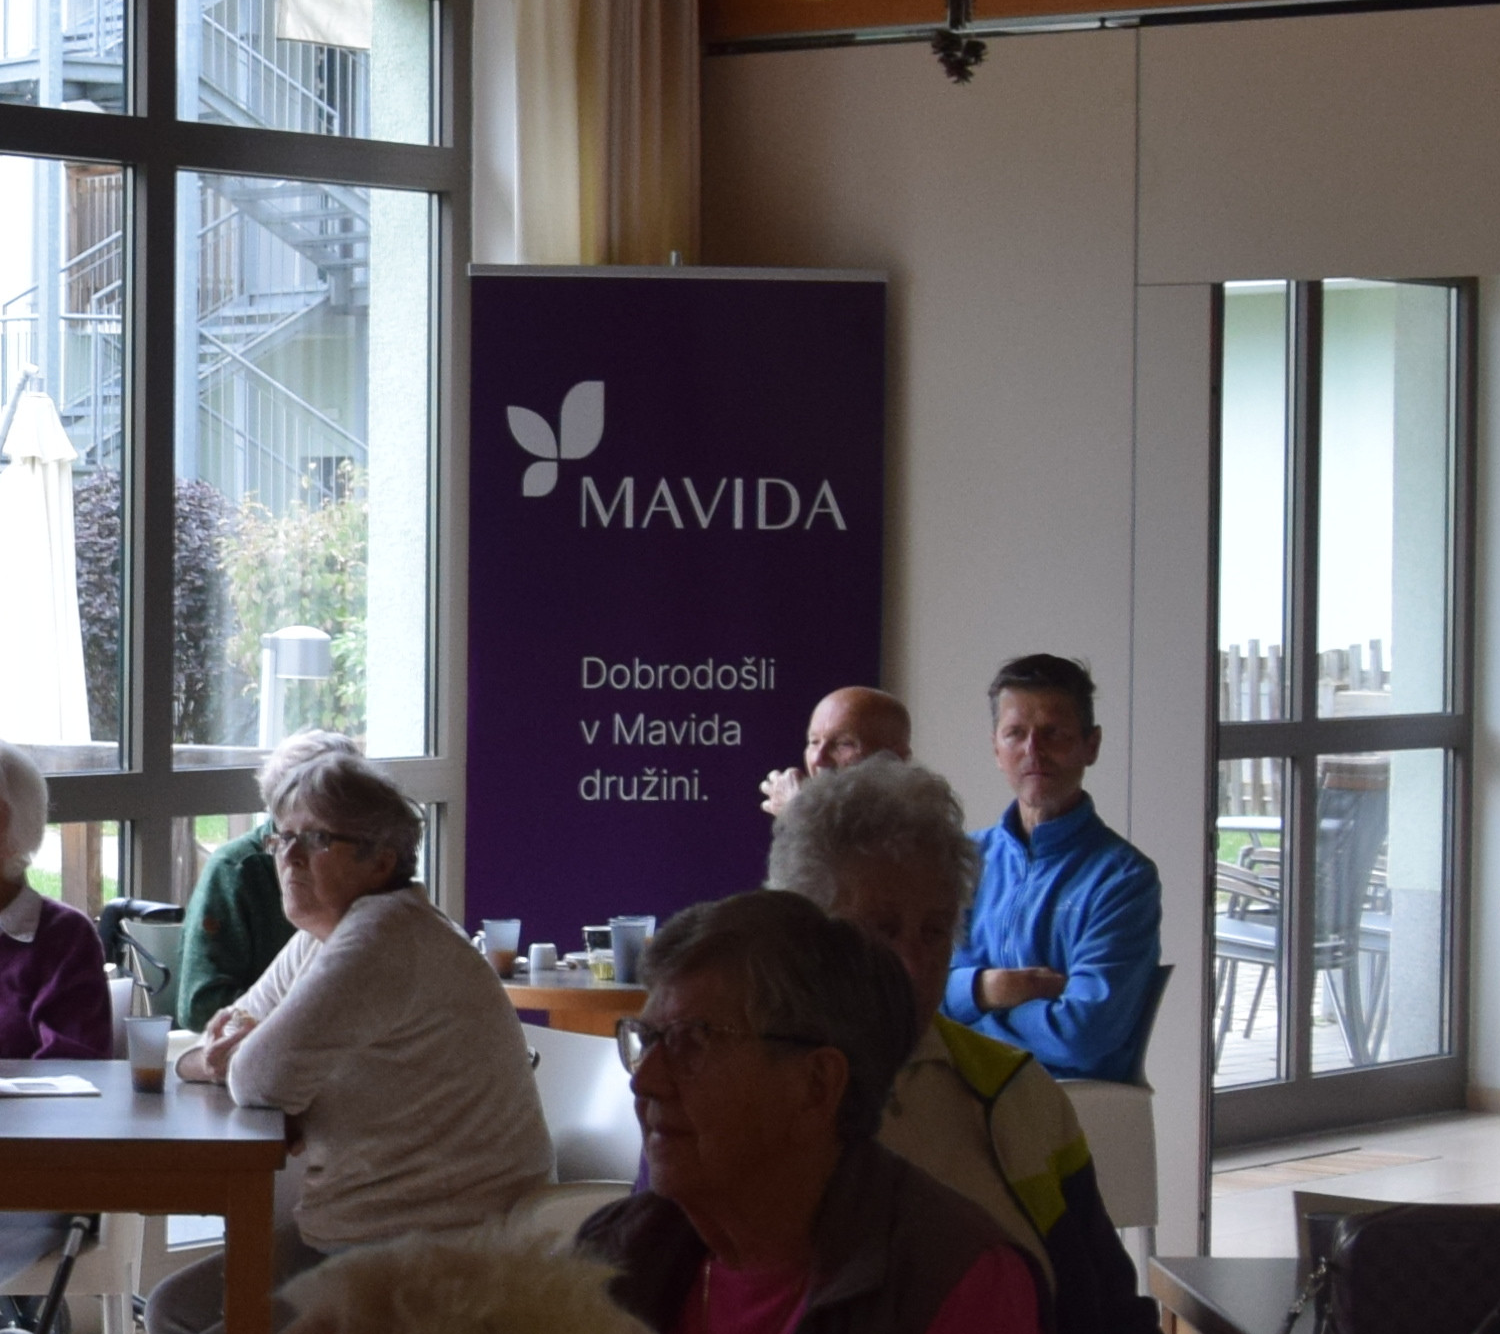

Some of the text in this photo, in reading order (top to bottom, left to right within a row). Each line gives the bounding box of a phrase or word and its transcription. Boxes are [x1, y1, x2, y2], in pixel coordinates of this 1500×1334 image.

[578, 476, 849, 531] MAVIDA
[580, 656, 777, 691] Dobrodošli
[579, 713, 743, 746] v Mavida
[579, 768, 710, 802] družini.
